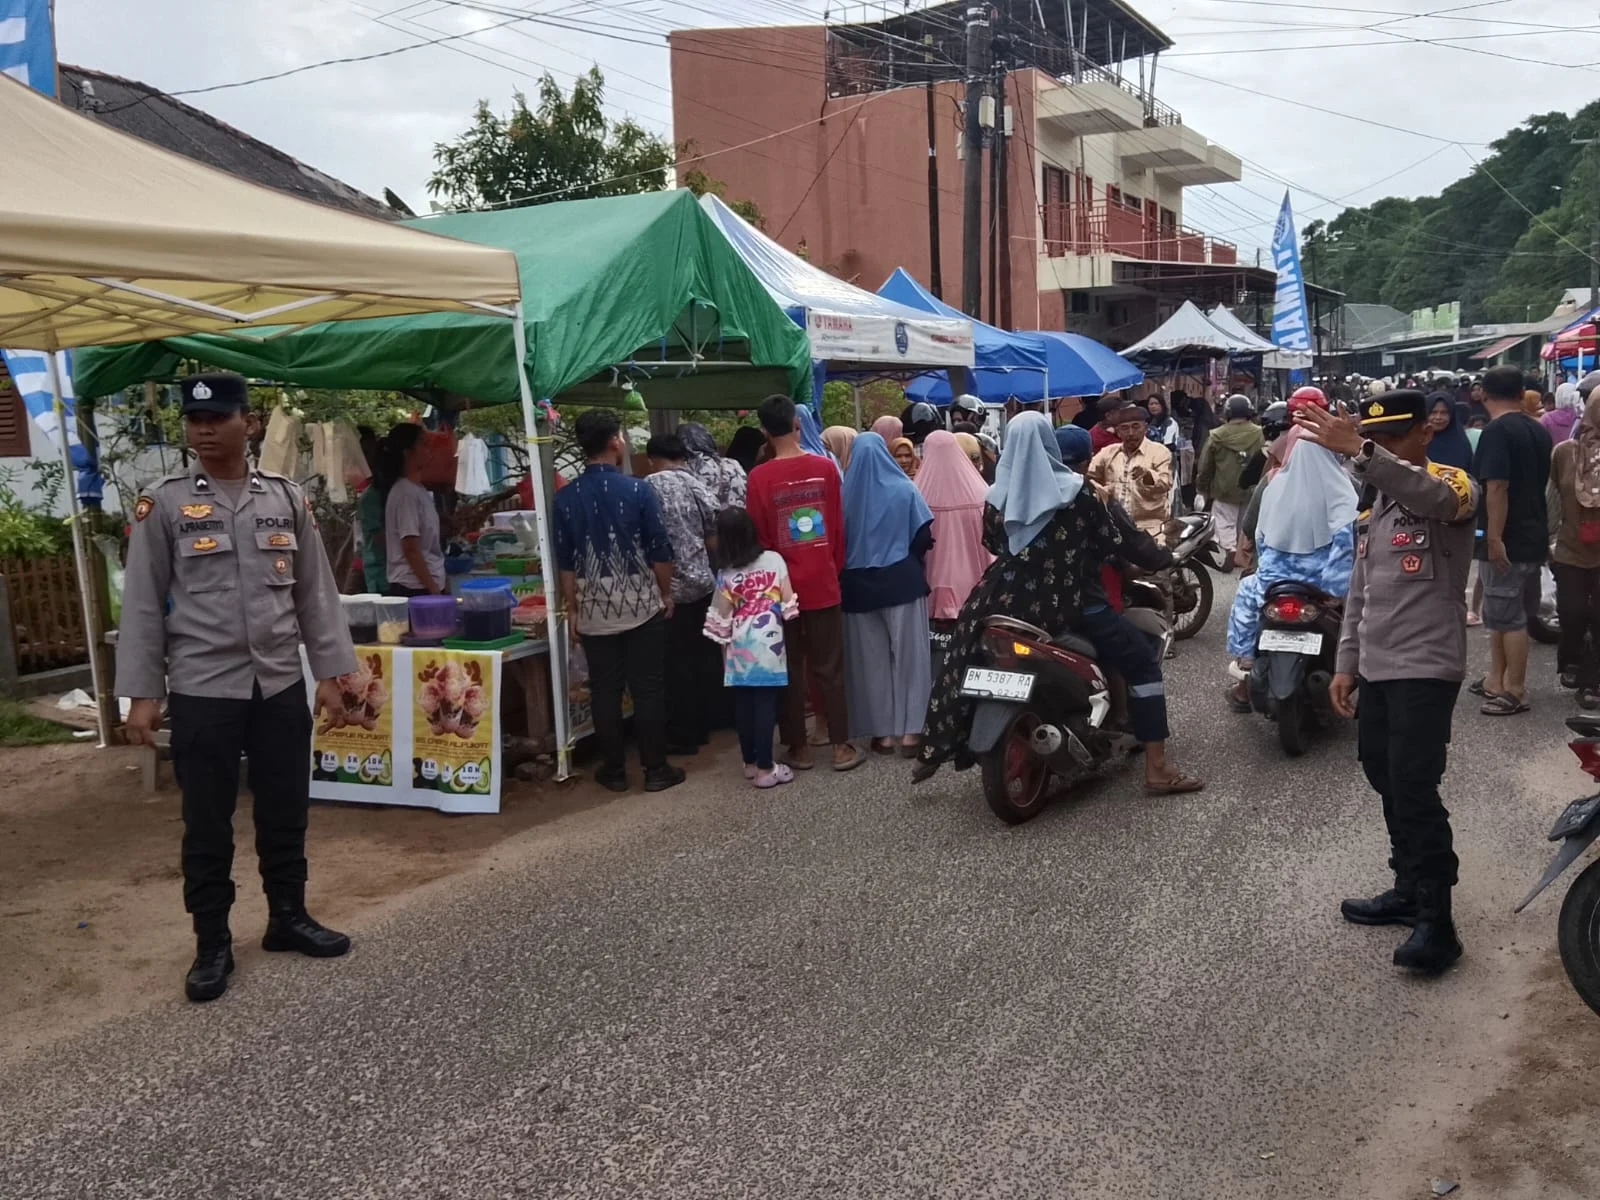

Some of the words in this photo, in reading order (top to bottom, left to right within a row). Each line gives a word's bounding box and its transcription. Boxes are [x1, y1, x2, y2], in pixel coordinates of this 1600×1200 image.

[255, 517, 293, 529] POLRI
[967, 670, 982, 681] BN
[986, 671, 1013, 685] 5387
